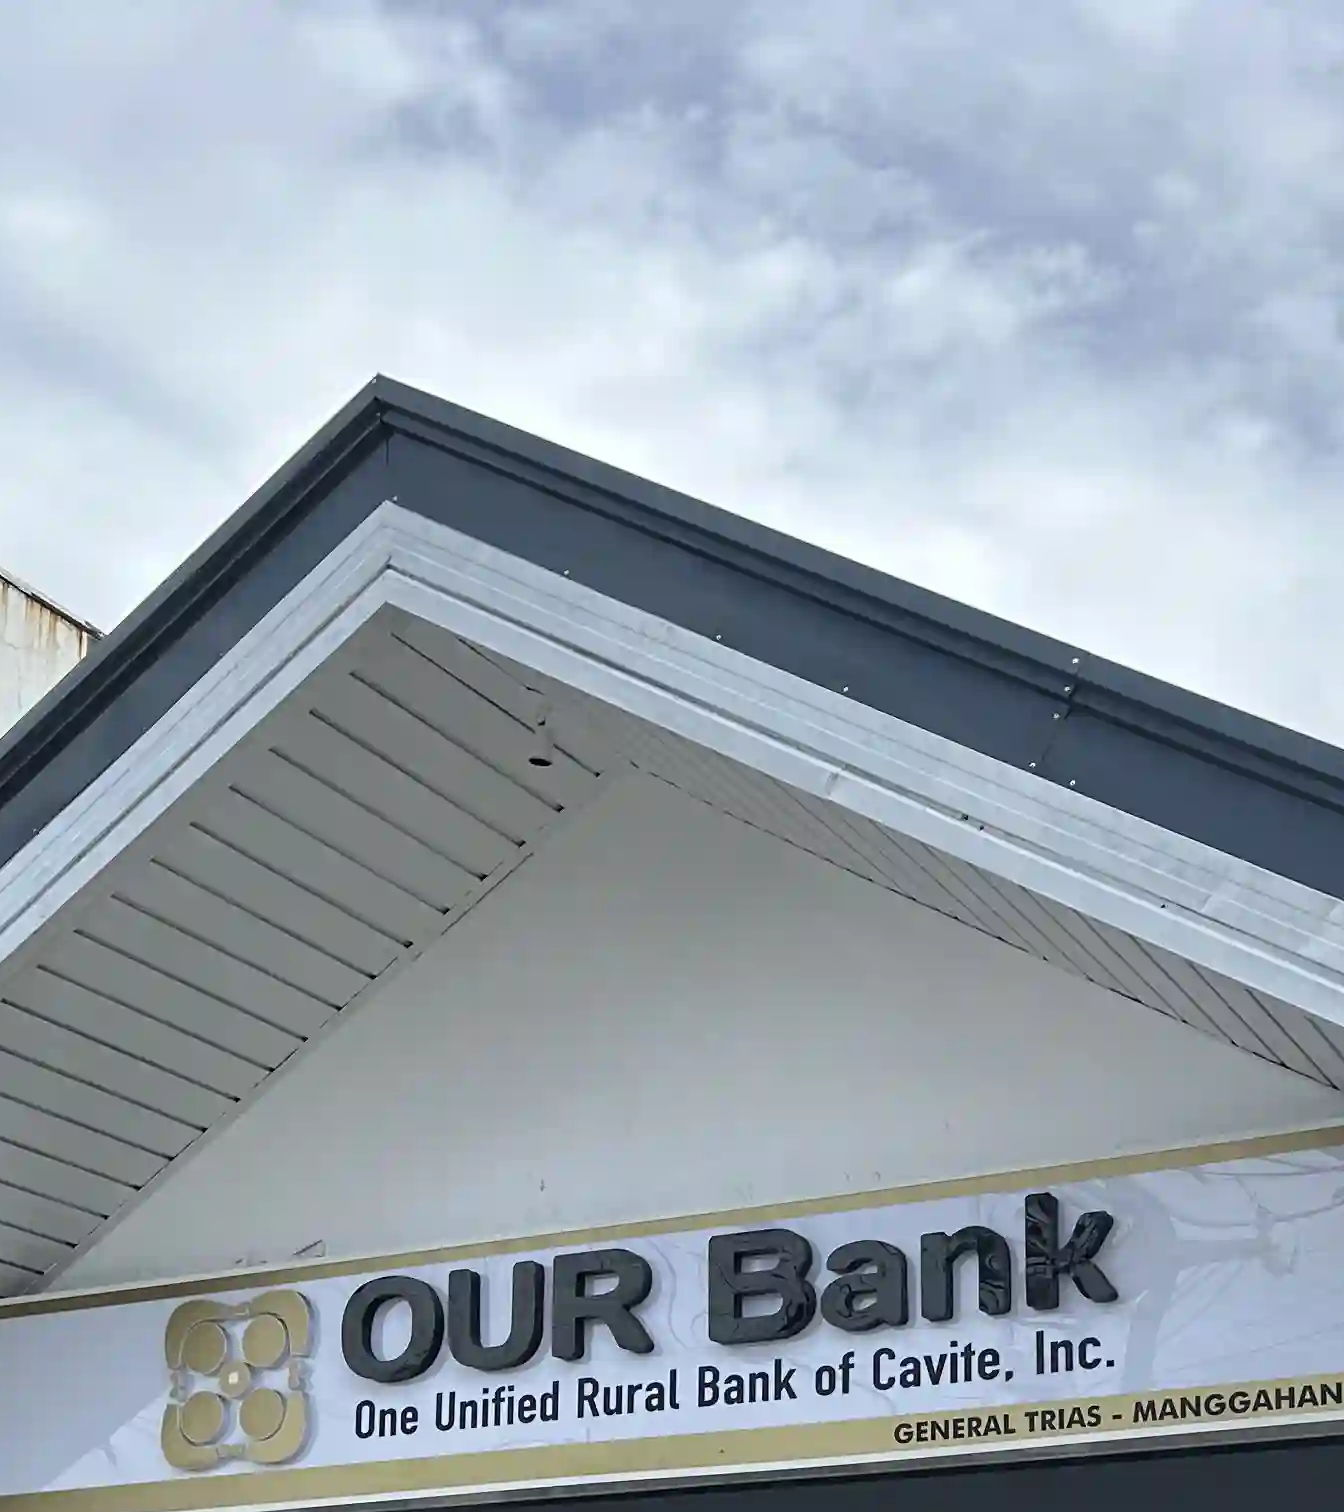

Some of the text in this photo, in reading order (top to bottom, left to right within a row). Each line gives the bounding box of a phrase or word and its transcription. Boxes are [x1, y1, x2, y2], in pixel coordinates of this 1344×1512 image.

[341, 1192, 1119, 1383] OUR Bank
[355, 1330, 1116, 1441] One Unified Rural Bank of Cavite, Inc.
[893, 1413, 1017, 1444] GENERAL
[1025, 1404, 1102, 1433] TRIAS
[1133, 1382, 1344, 1425] MANGGAHAN
